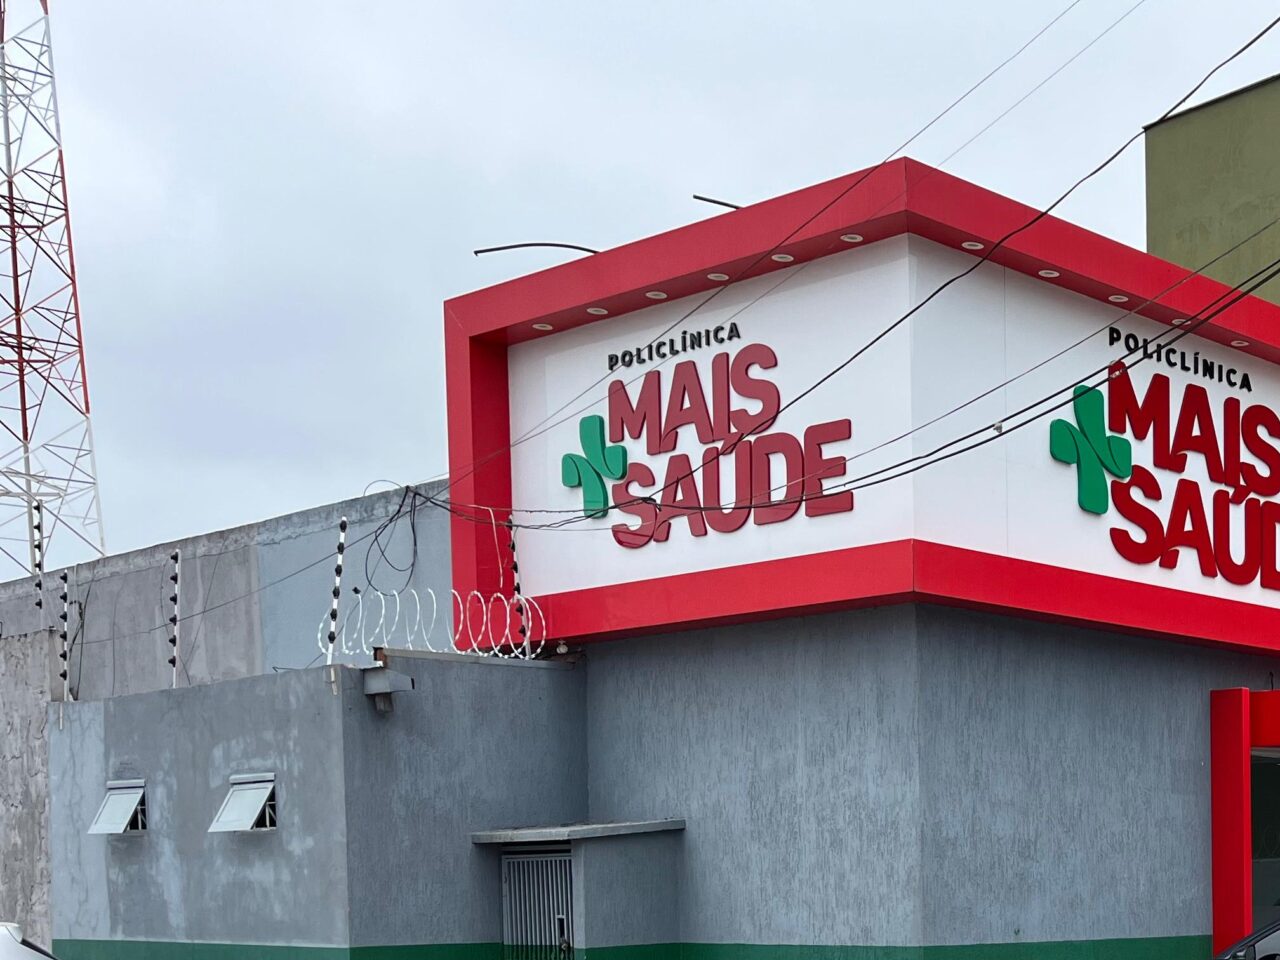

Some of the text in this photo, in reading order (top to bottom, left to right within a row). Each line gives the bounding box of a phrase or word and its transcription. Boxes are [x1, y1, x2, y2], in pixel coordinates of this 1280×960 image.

[607, 321, 742, 371] POLICLÍNICA
[1108, 326, 1253, 392] POLICLÍNICA
[608, 343, 781, 455] MAIS
[611, 418, 854, 549] SAÚDE
